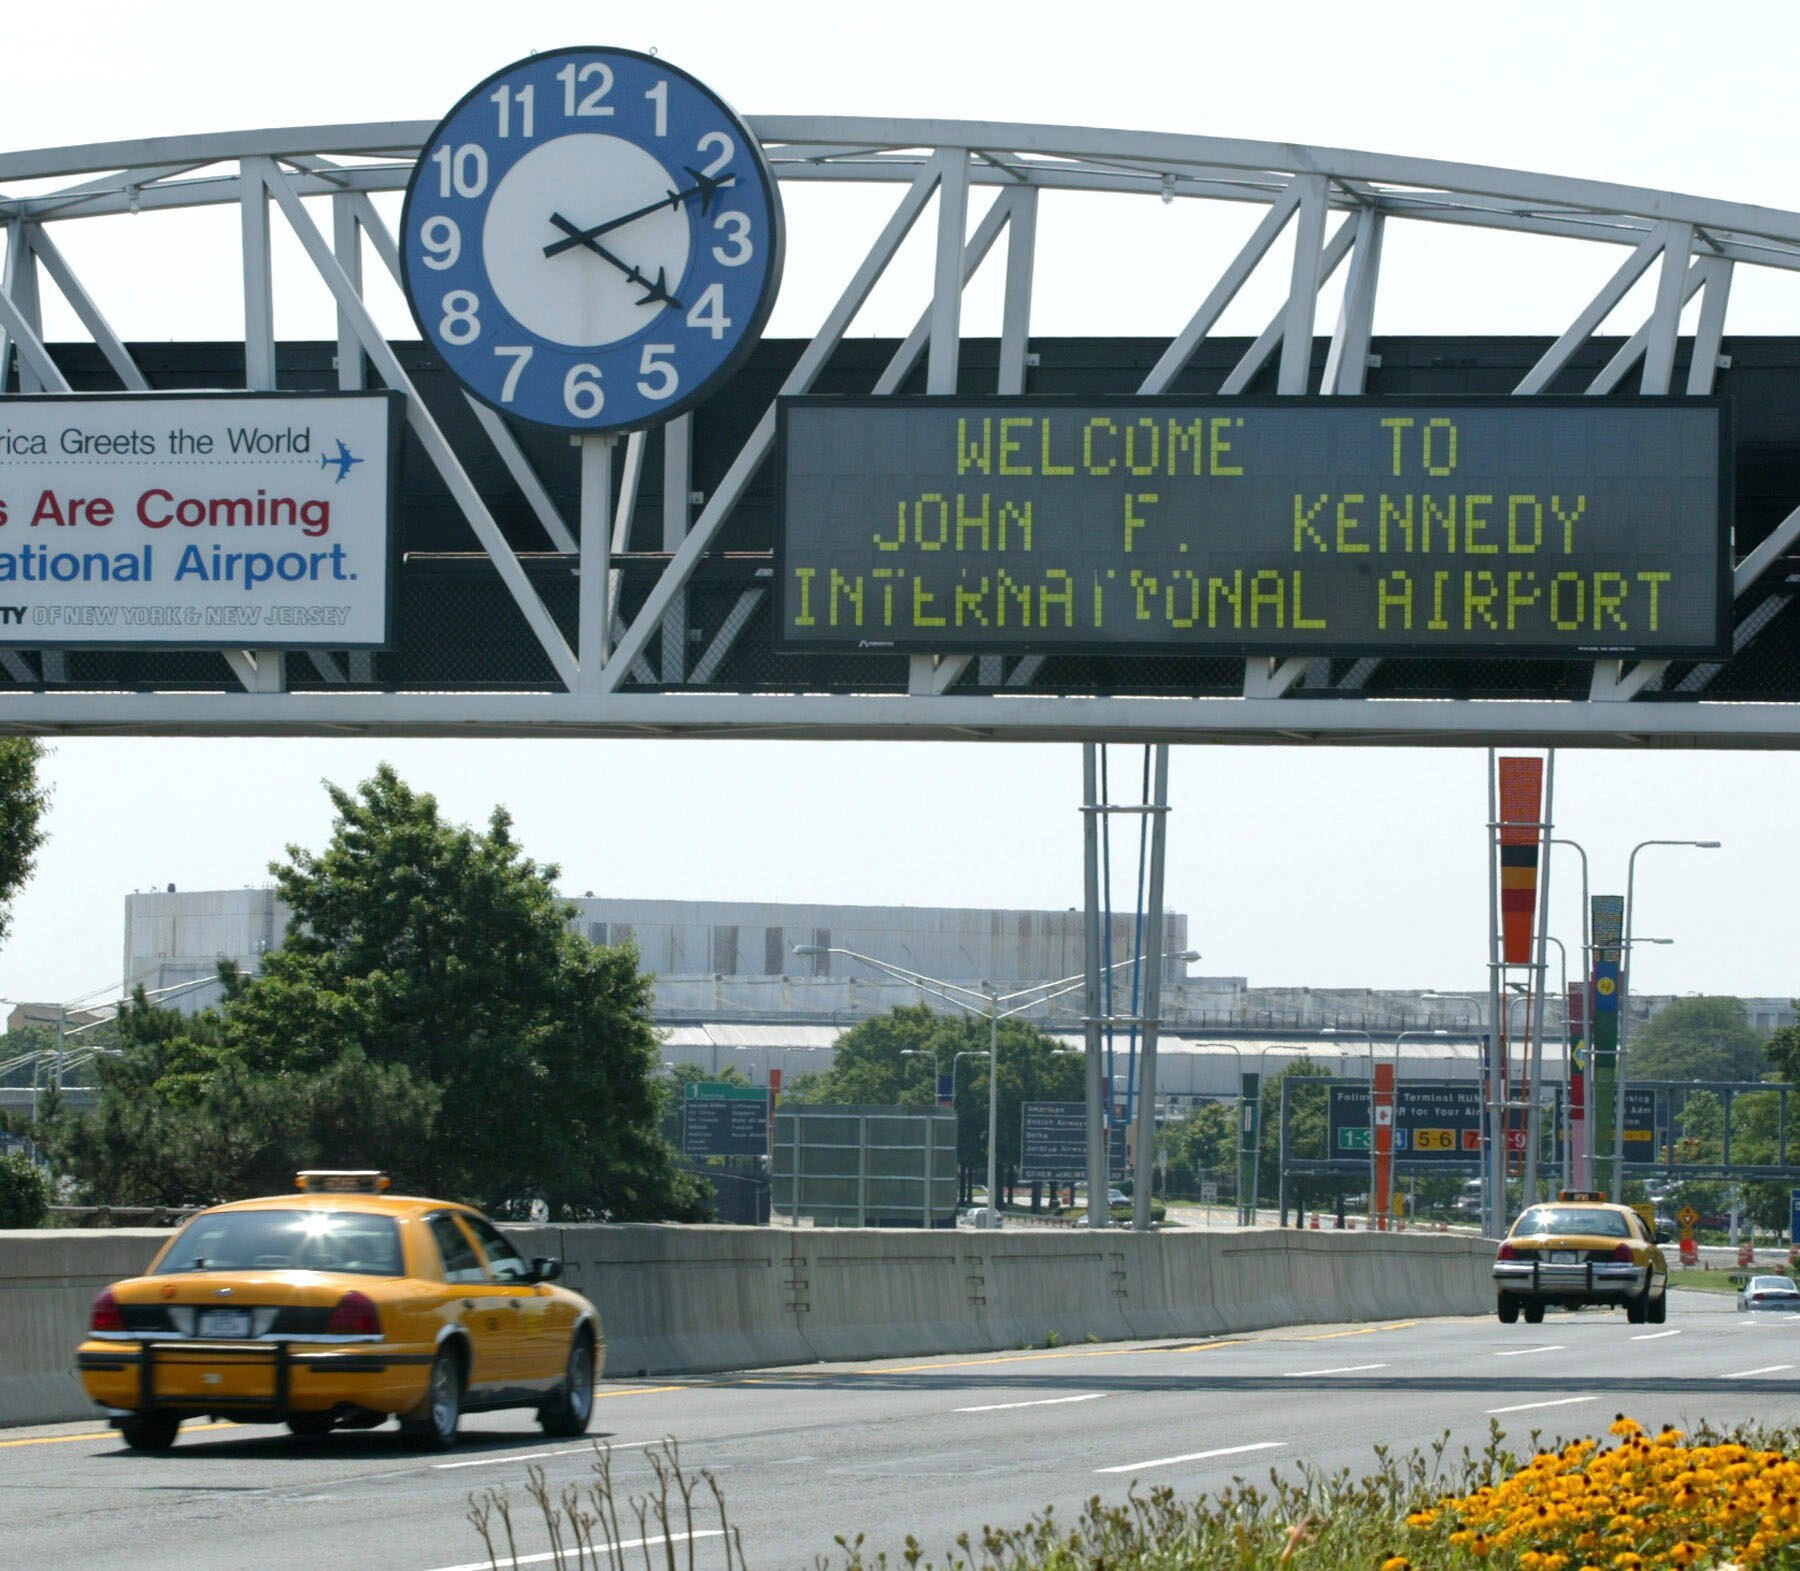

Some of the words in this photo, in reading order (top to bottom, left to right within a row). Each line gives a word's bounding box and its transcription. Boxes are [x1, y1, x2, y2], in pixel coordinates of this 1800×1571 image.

[490, 84, 534, 138] 11
[556, 62, 615, 117] 12
[645, 80, 668, 137] 1
[432, 143, 489, 199] 10
[696, 131, 736, 188] 2
[420, 215, 462, 271] 9
[711, 210, 754, 268] 3
[438, 289, 482, 346] 8
[686, 283, 732, 340] 4
[494, 345, 534, 402] 7
[563, 363, 605, 419] 6
[636, 343, 680, 400] 5
[60, 428, 156, 455] Greets
[168, 428, 214, 454] the
[227, 426, 311, 454] World
[958, 418, 1243, 476] WELCOME
[1380, 418, 1457, 476] TO
[30, 489, 115, 527] Are
[136, 488, 330, 537] Coming
[873, 493, 1032, 551] JOHN
[1294, 494, 1586, 554] KENNEDY
[174, 543, 358, 591] Airport.
[33, 605, 62, 625] OF
[64, 605, 118, 625] NEW
[121, 605, 182, 626] YORK
[184, 606, 201, 625] &
[205, 605, 261, 625] NEW
[264, 605, 351, 625] JERSEY
[1378, 570, 1671, 630] AIRPORT
[1419, 1132, 1451, 1147] 5-6
